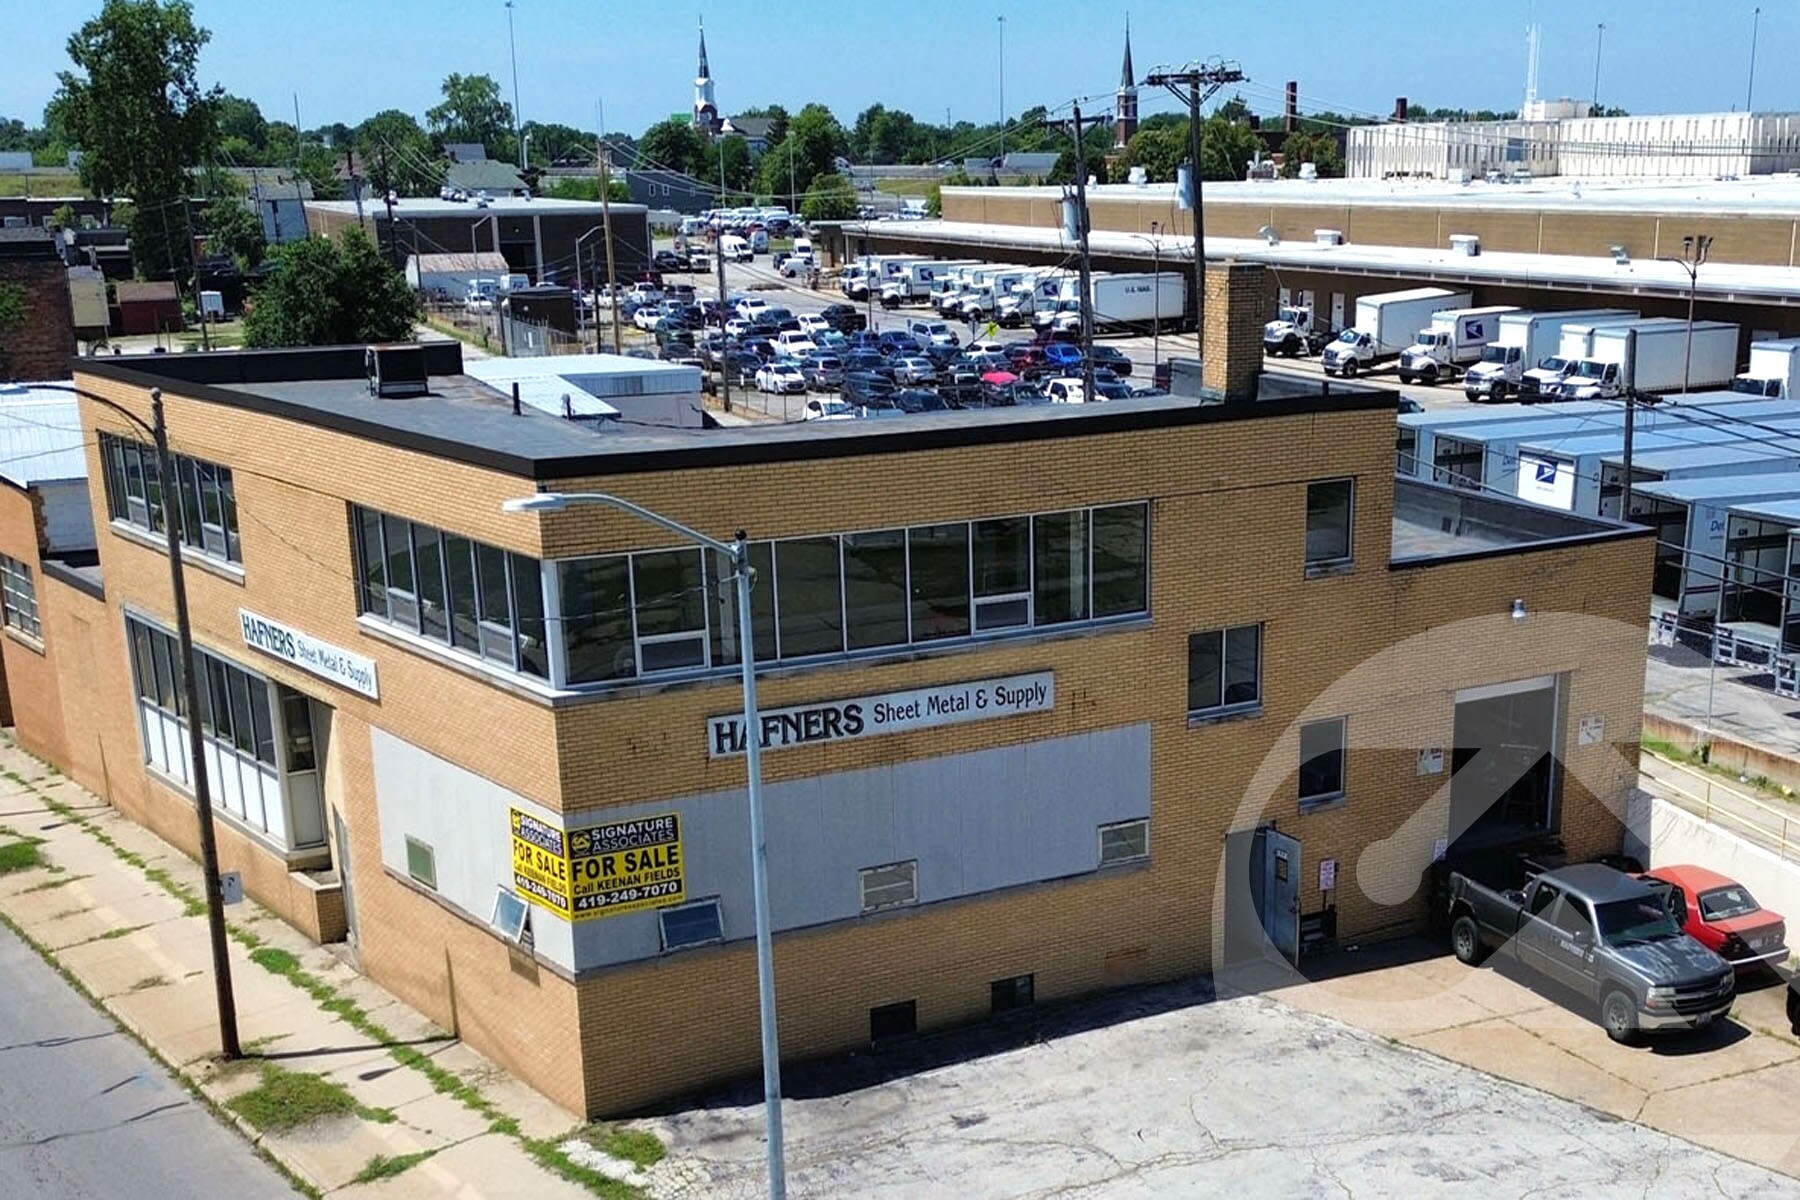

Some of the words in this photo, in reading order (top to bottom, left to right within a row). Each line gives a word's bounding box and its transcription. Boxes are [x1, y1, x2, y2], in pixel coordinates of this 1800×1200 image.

[241, 614, 296, 659] HAFNERS
[297, 640, 317, 664] Sheet
[318, 649, 339, 672] Metal
[339, 656, 346, 676] &
[347, 660, 373, 691] Supply
[873, 700, 921, 724] Sheet
[927, 691, 969, 716] Metal
[975, 689, 989, 709] &
[995, 681, 1048, 709] Supply
[591, 817, 673, 840] SIGNATURE
[592, 829, 674, 853] ASSOCIATES
[513, 838, 533, 866] FOR
[537, 850, 567, 881] SALE
[571, 856, 616, 881] FOR
[624, 845, 679, 873] SALE
[573, 882, 594, 895] Call
[597, 874, 641, 891] KEENAN
[644, 867, 680, 882] FIELDS
[578, 881, 678, 909] 419-249-7070
